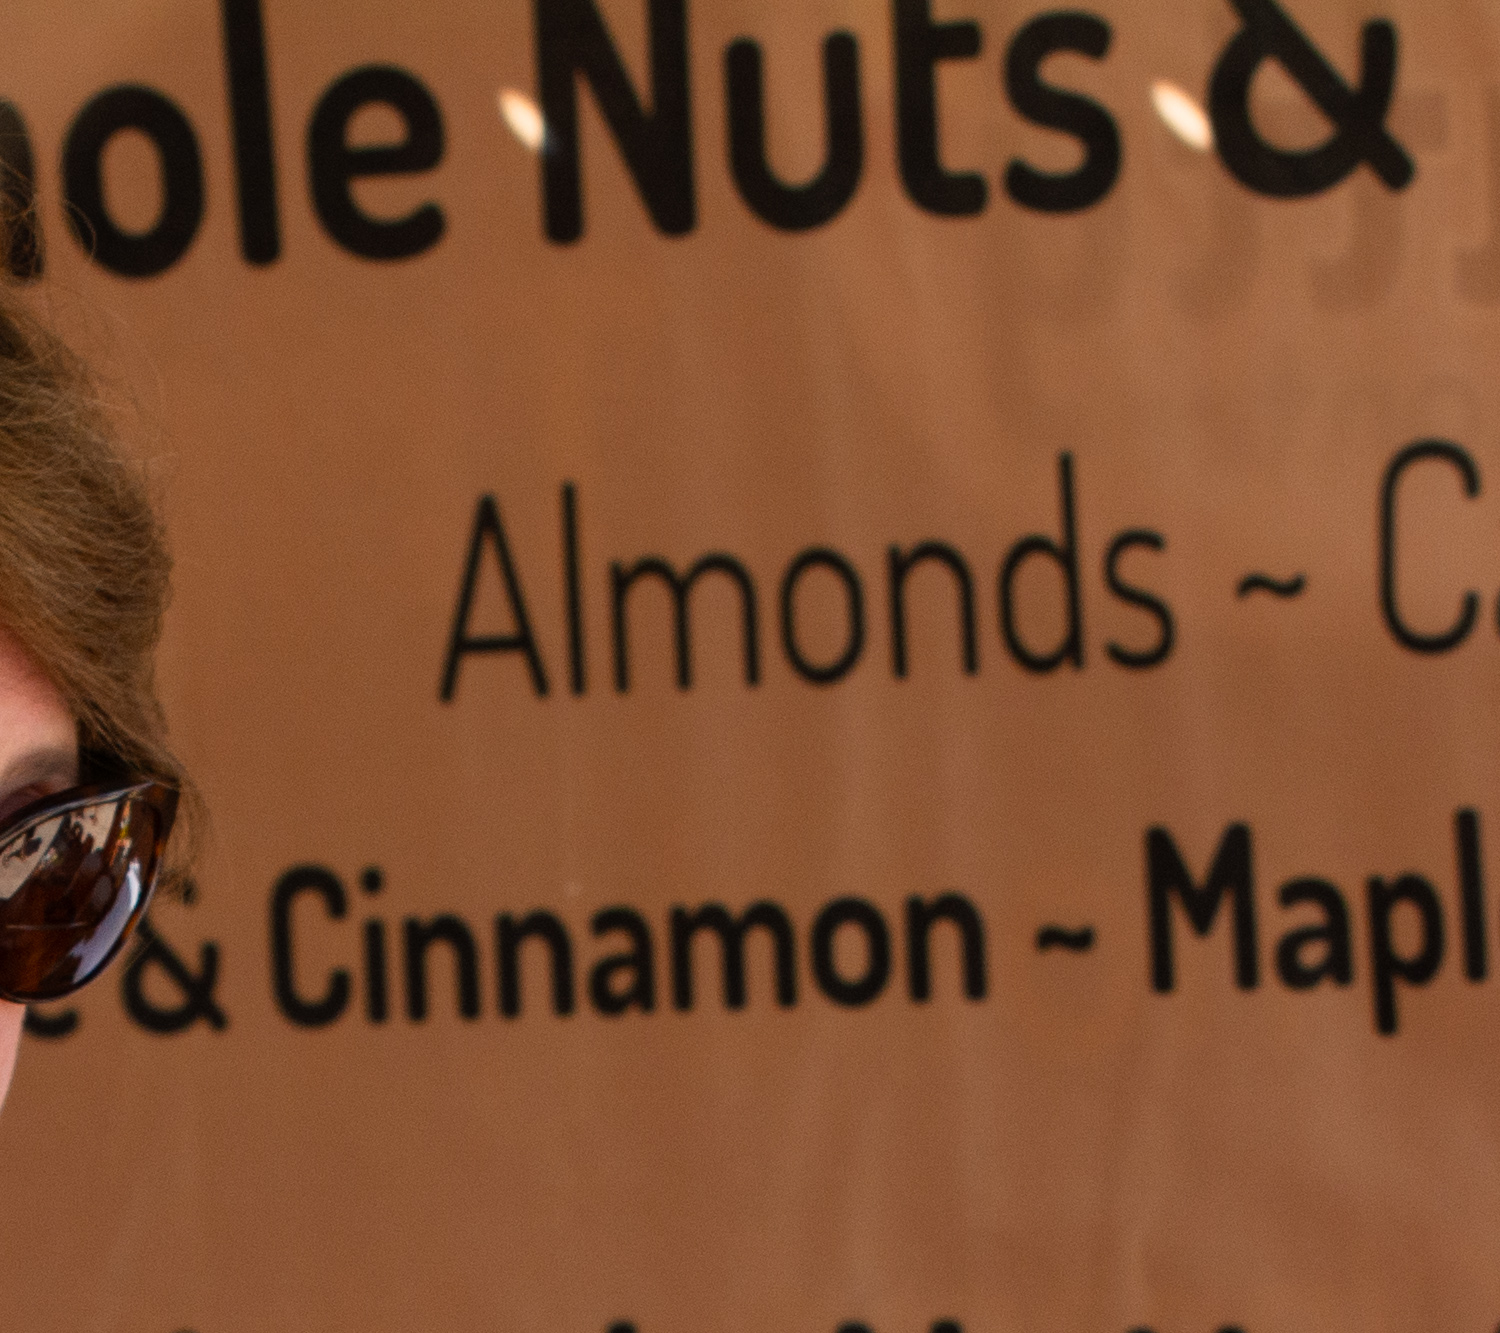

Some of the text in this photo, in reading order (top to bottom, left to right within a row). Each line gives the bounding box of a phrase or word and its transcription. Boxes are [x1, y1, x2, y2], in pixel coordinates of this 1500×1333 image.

[527, 0, 1124, 247] Nuts
[1204, 0, 1420, 200] &
[438, 448, 1180, 706] Almonds
[118, 910, 228, 1037] &
[268, 862, 990, 1034] Cinnamon
